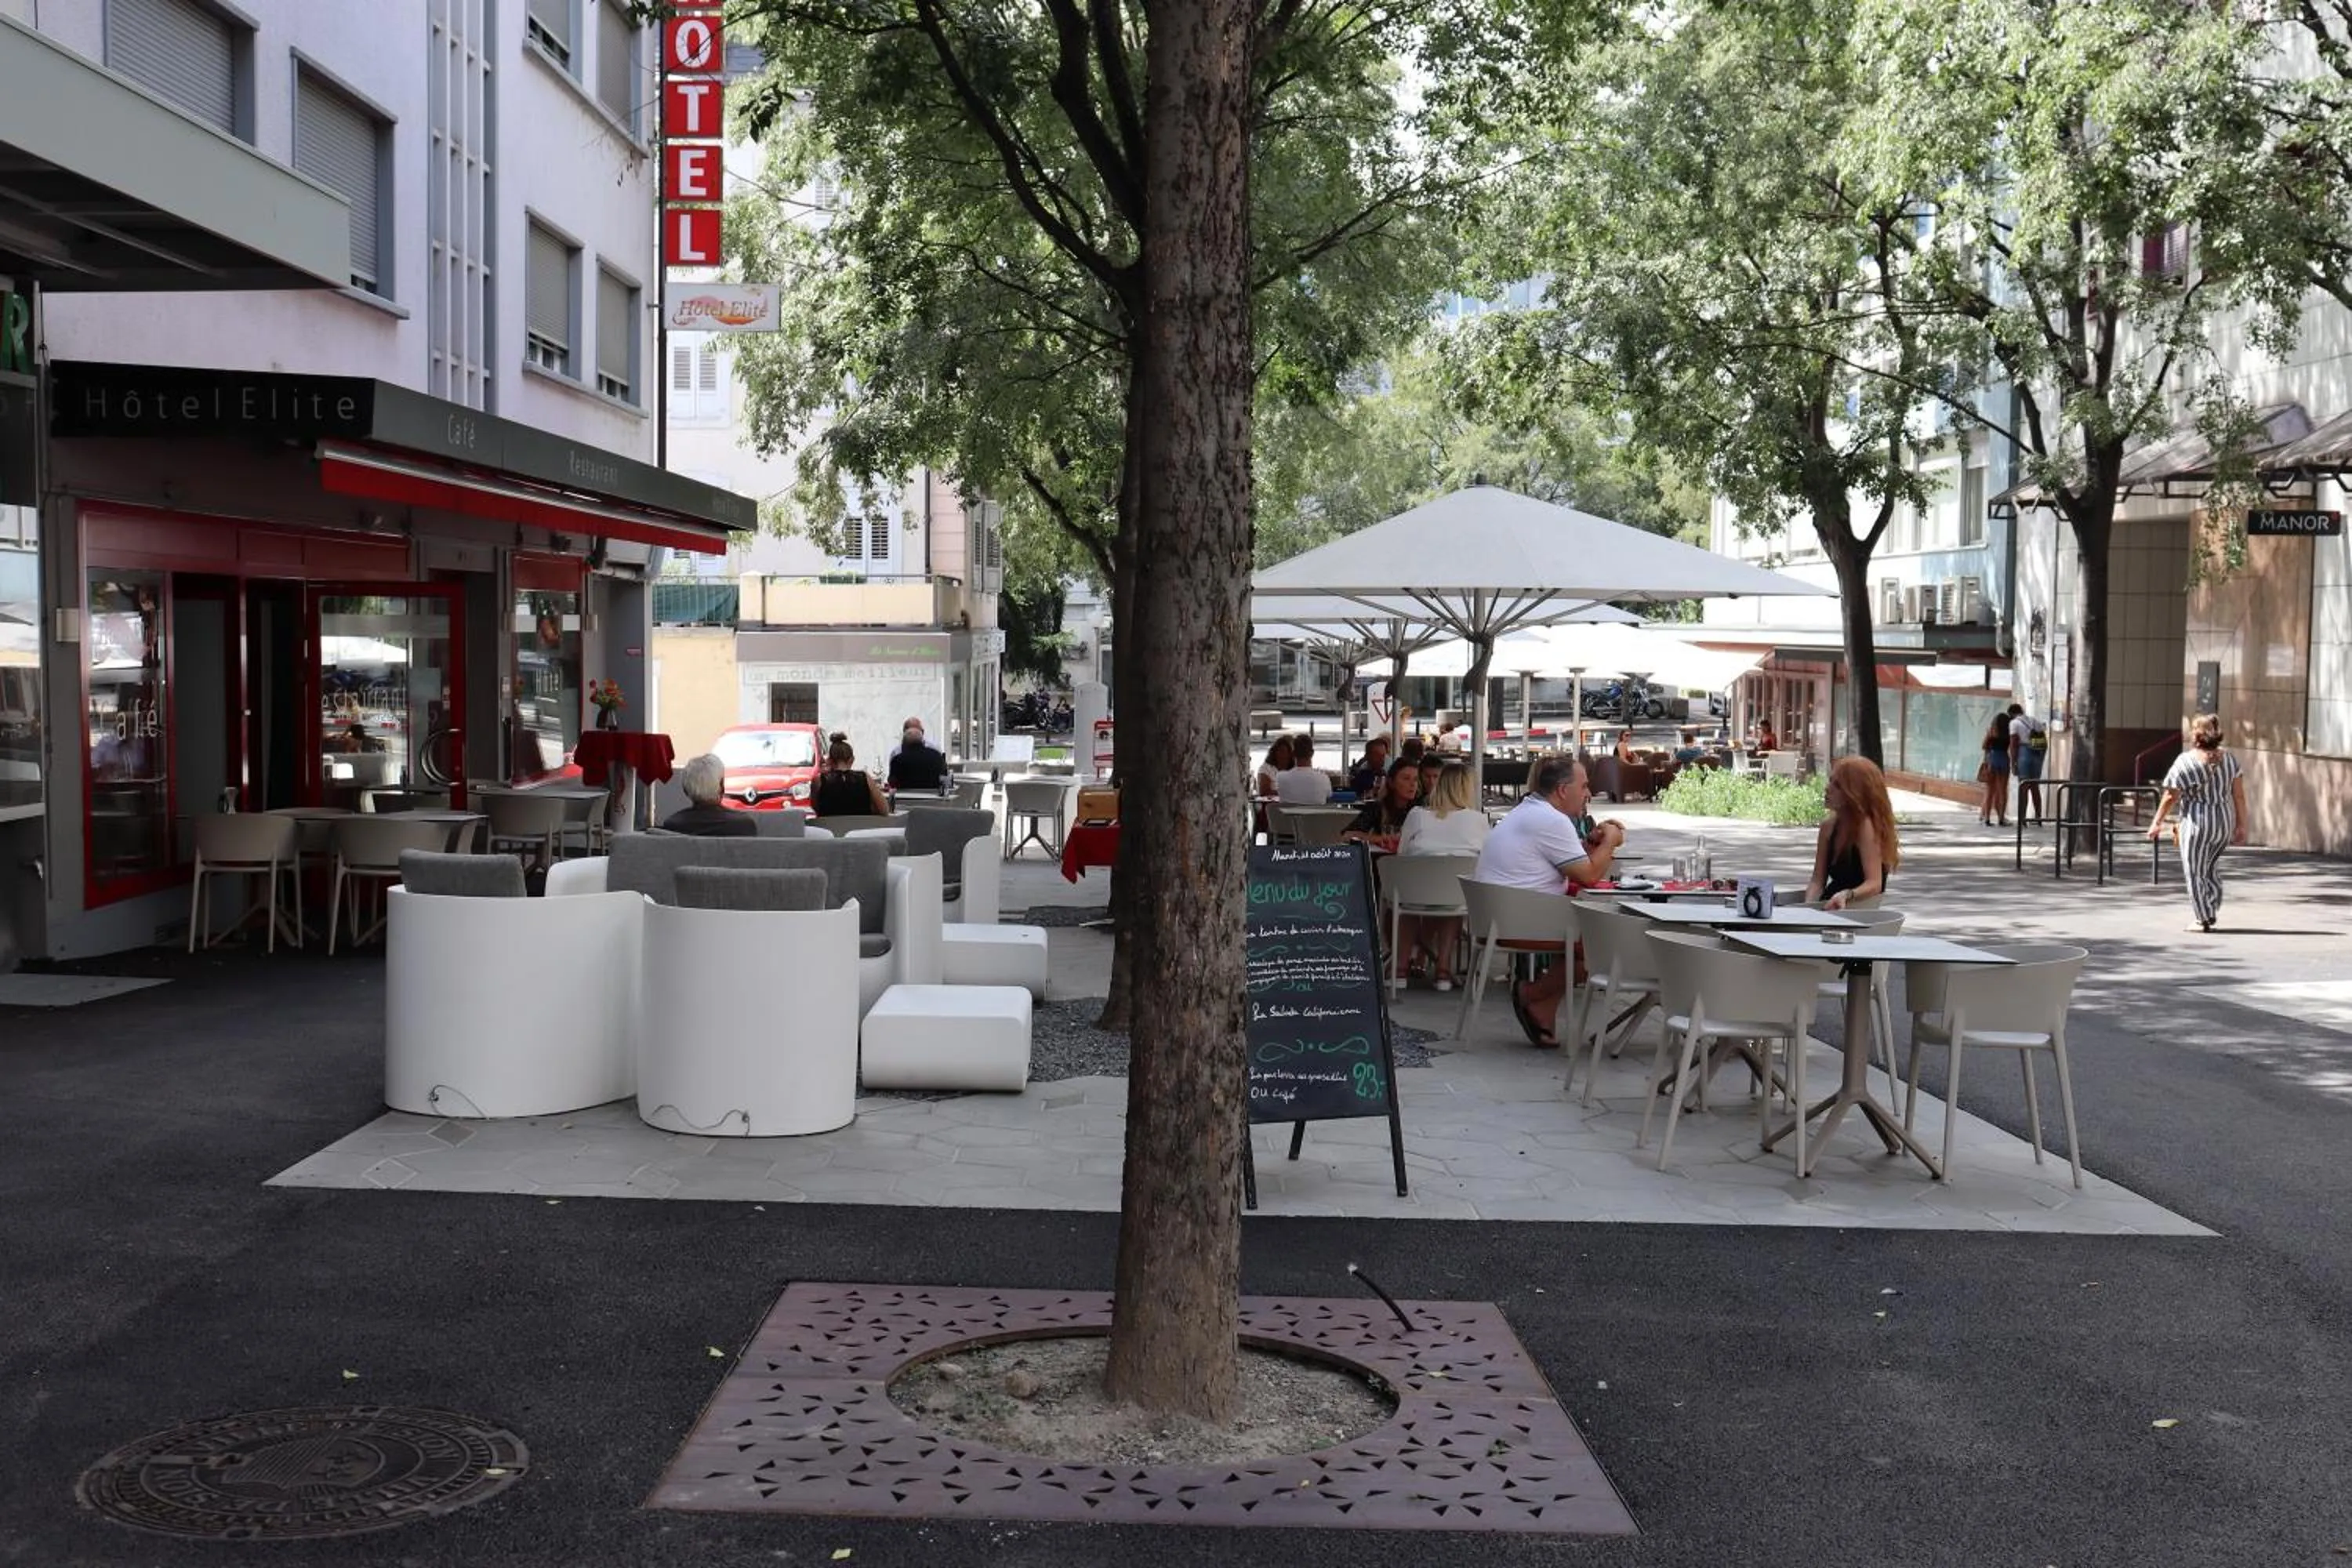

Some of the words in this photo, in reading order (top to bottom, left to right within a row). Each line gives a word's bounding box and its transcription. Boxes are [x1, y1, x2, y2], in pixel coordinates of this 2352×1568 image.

[675, 0, 712, 262] OTEL
[85, 387, 220, 419] Hôtel
[241, 387, 356, 420] Elite
[447, 412, 476, 449] Café
[2259, 514, 2330, 531] MANOR
[1248, 881, 1286, 904] enu
[1288, 872, 1309, 902] du
[390, 1427, 463, 1462] SION
[152, 1468, 220, 1508] SION
